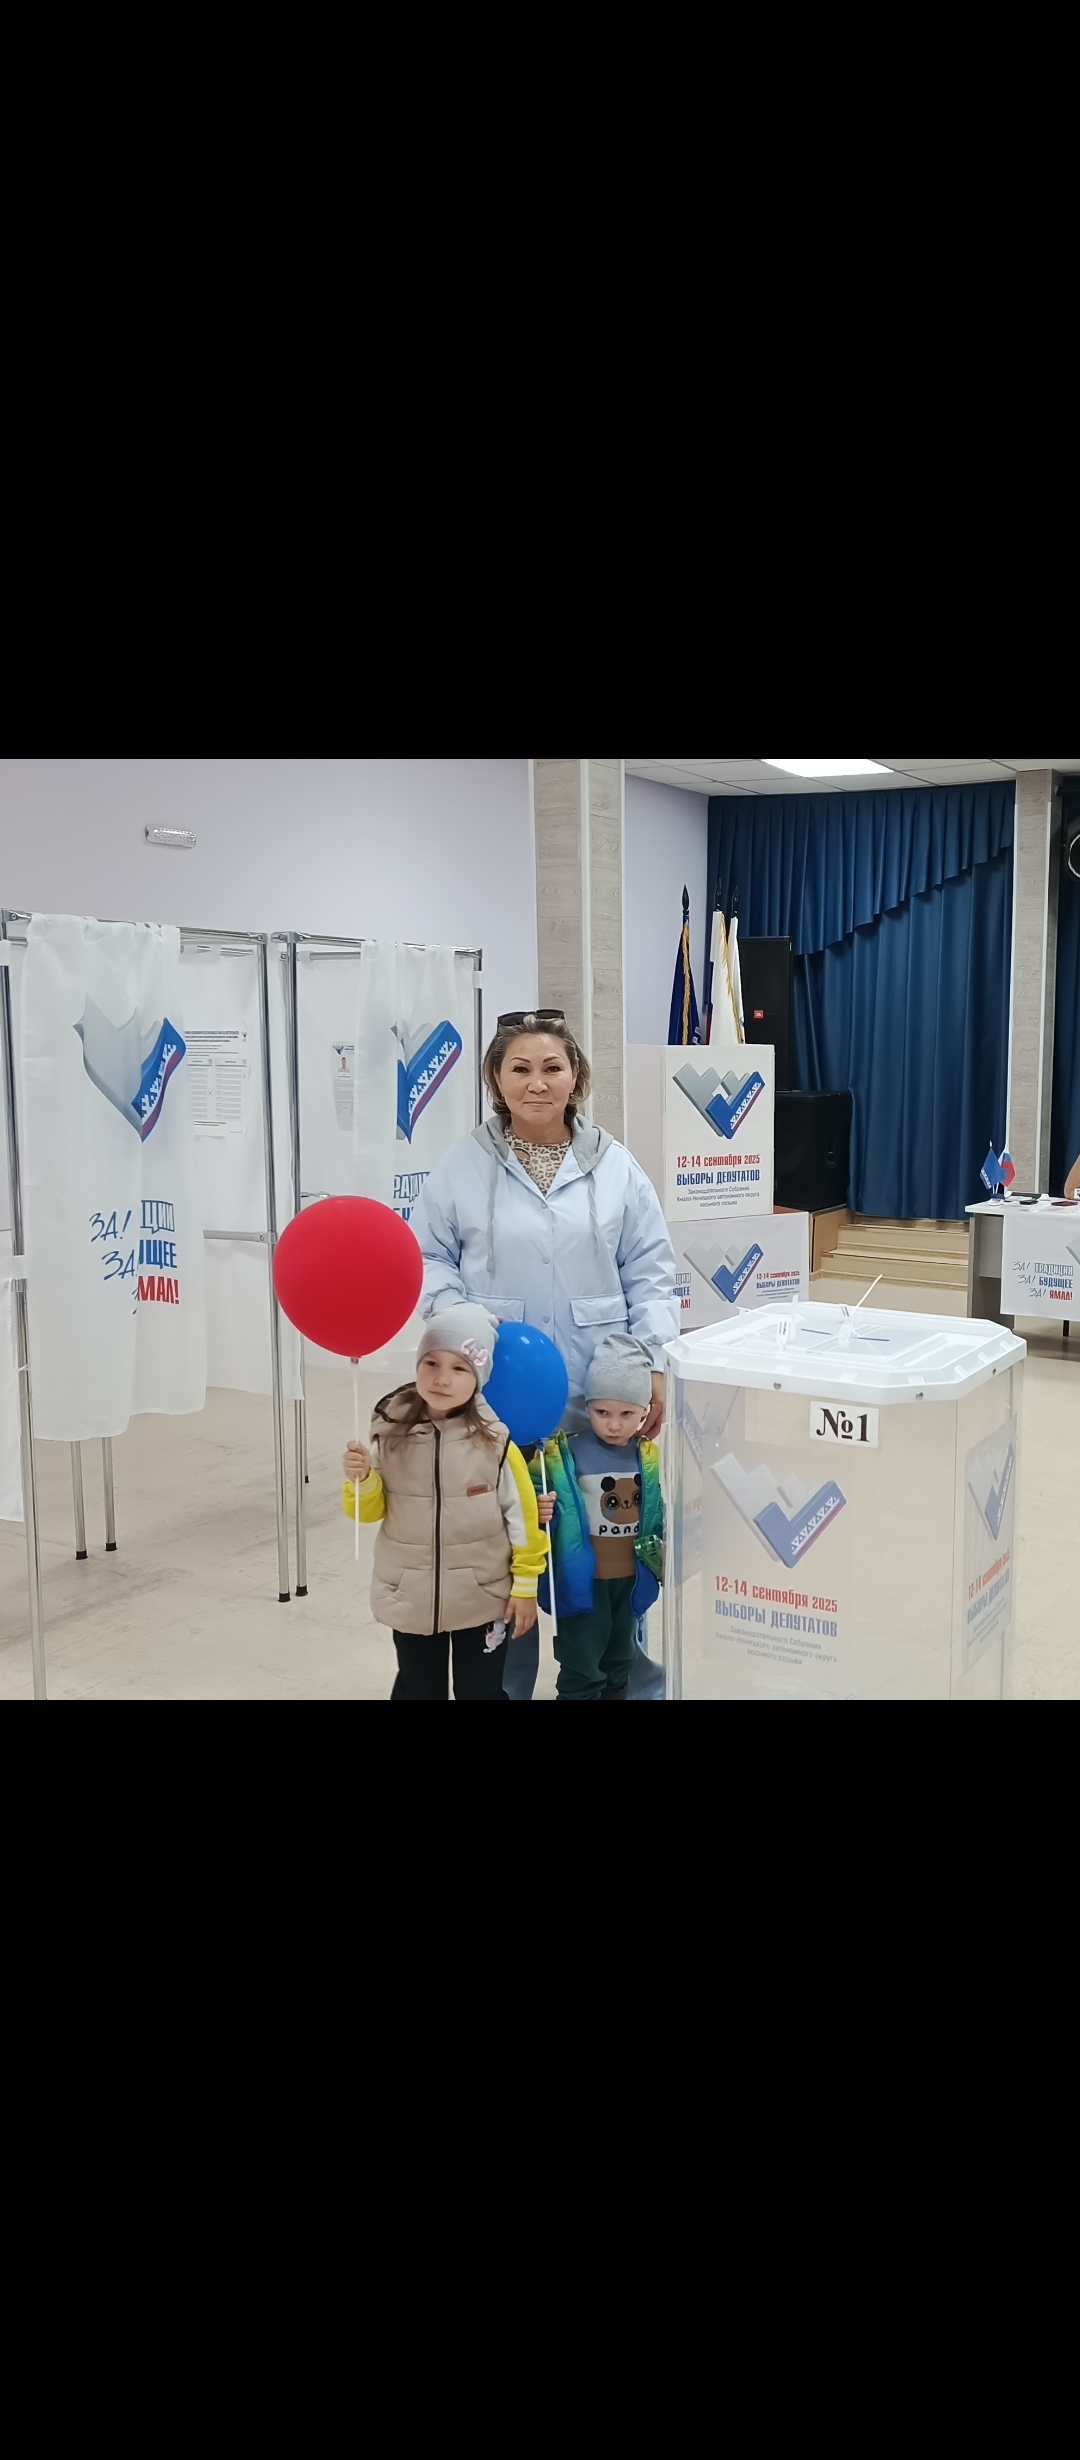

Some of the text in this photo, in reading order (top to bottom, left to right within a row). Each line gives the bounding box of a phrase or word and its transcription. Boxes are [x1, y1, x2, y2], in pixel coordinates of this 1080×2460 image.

[677, 1154, 760, 1168] 12-14 сентября 2025
[676, 1169, 760, 1186] ВЫБОРЫ ДЕПУТАТОВ
[89, 1210, 132, 1242] ЗА!
[1034, 1262, 1074, 1277] ТРАДИЦИИ
[138, 1275, 180, 1305] МАЛ!
[1039, 1276, 1073, 1289] БУДУЩЕЕ
[1049, 1289, 1073, 1301] ЯМАЛ!
[815, 1407, 871, 1443] №1
[599, 1522, 640, 1536] pand
[715, 1575, 838, 1613] 12-14 сентября 2025
[715, 1599, 838, 1638] ВЫБОРЫ ДЕПУТАТОВ
